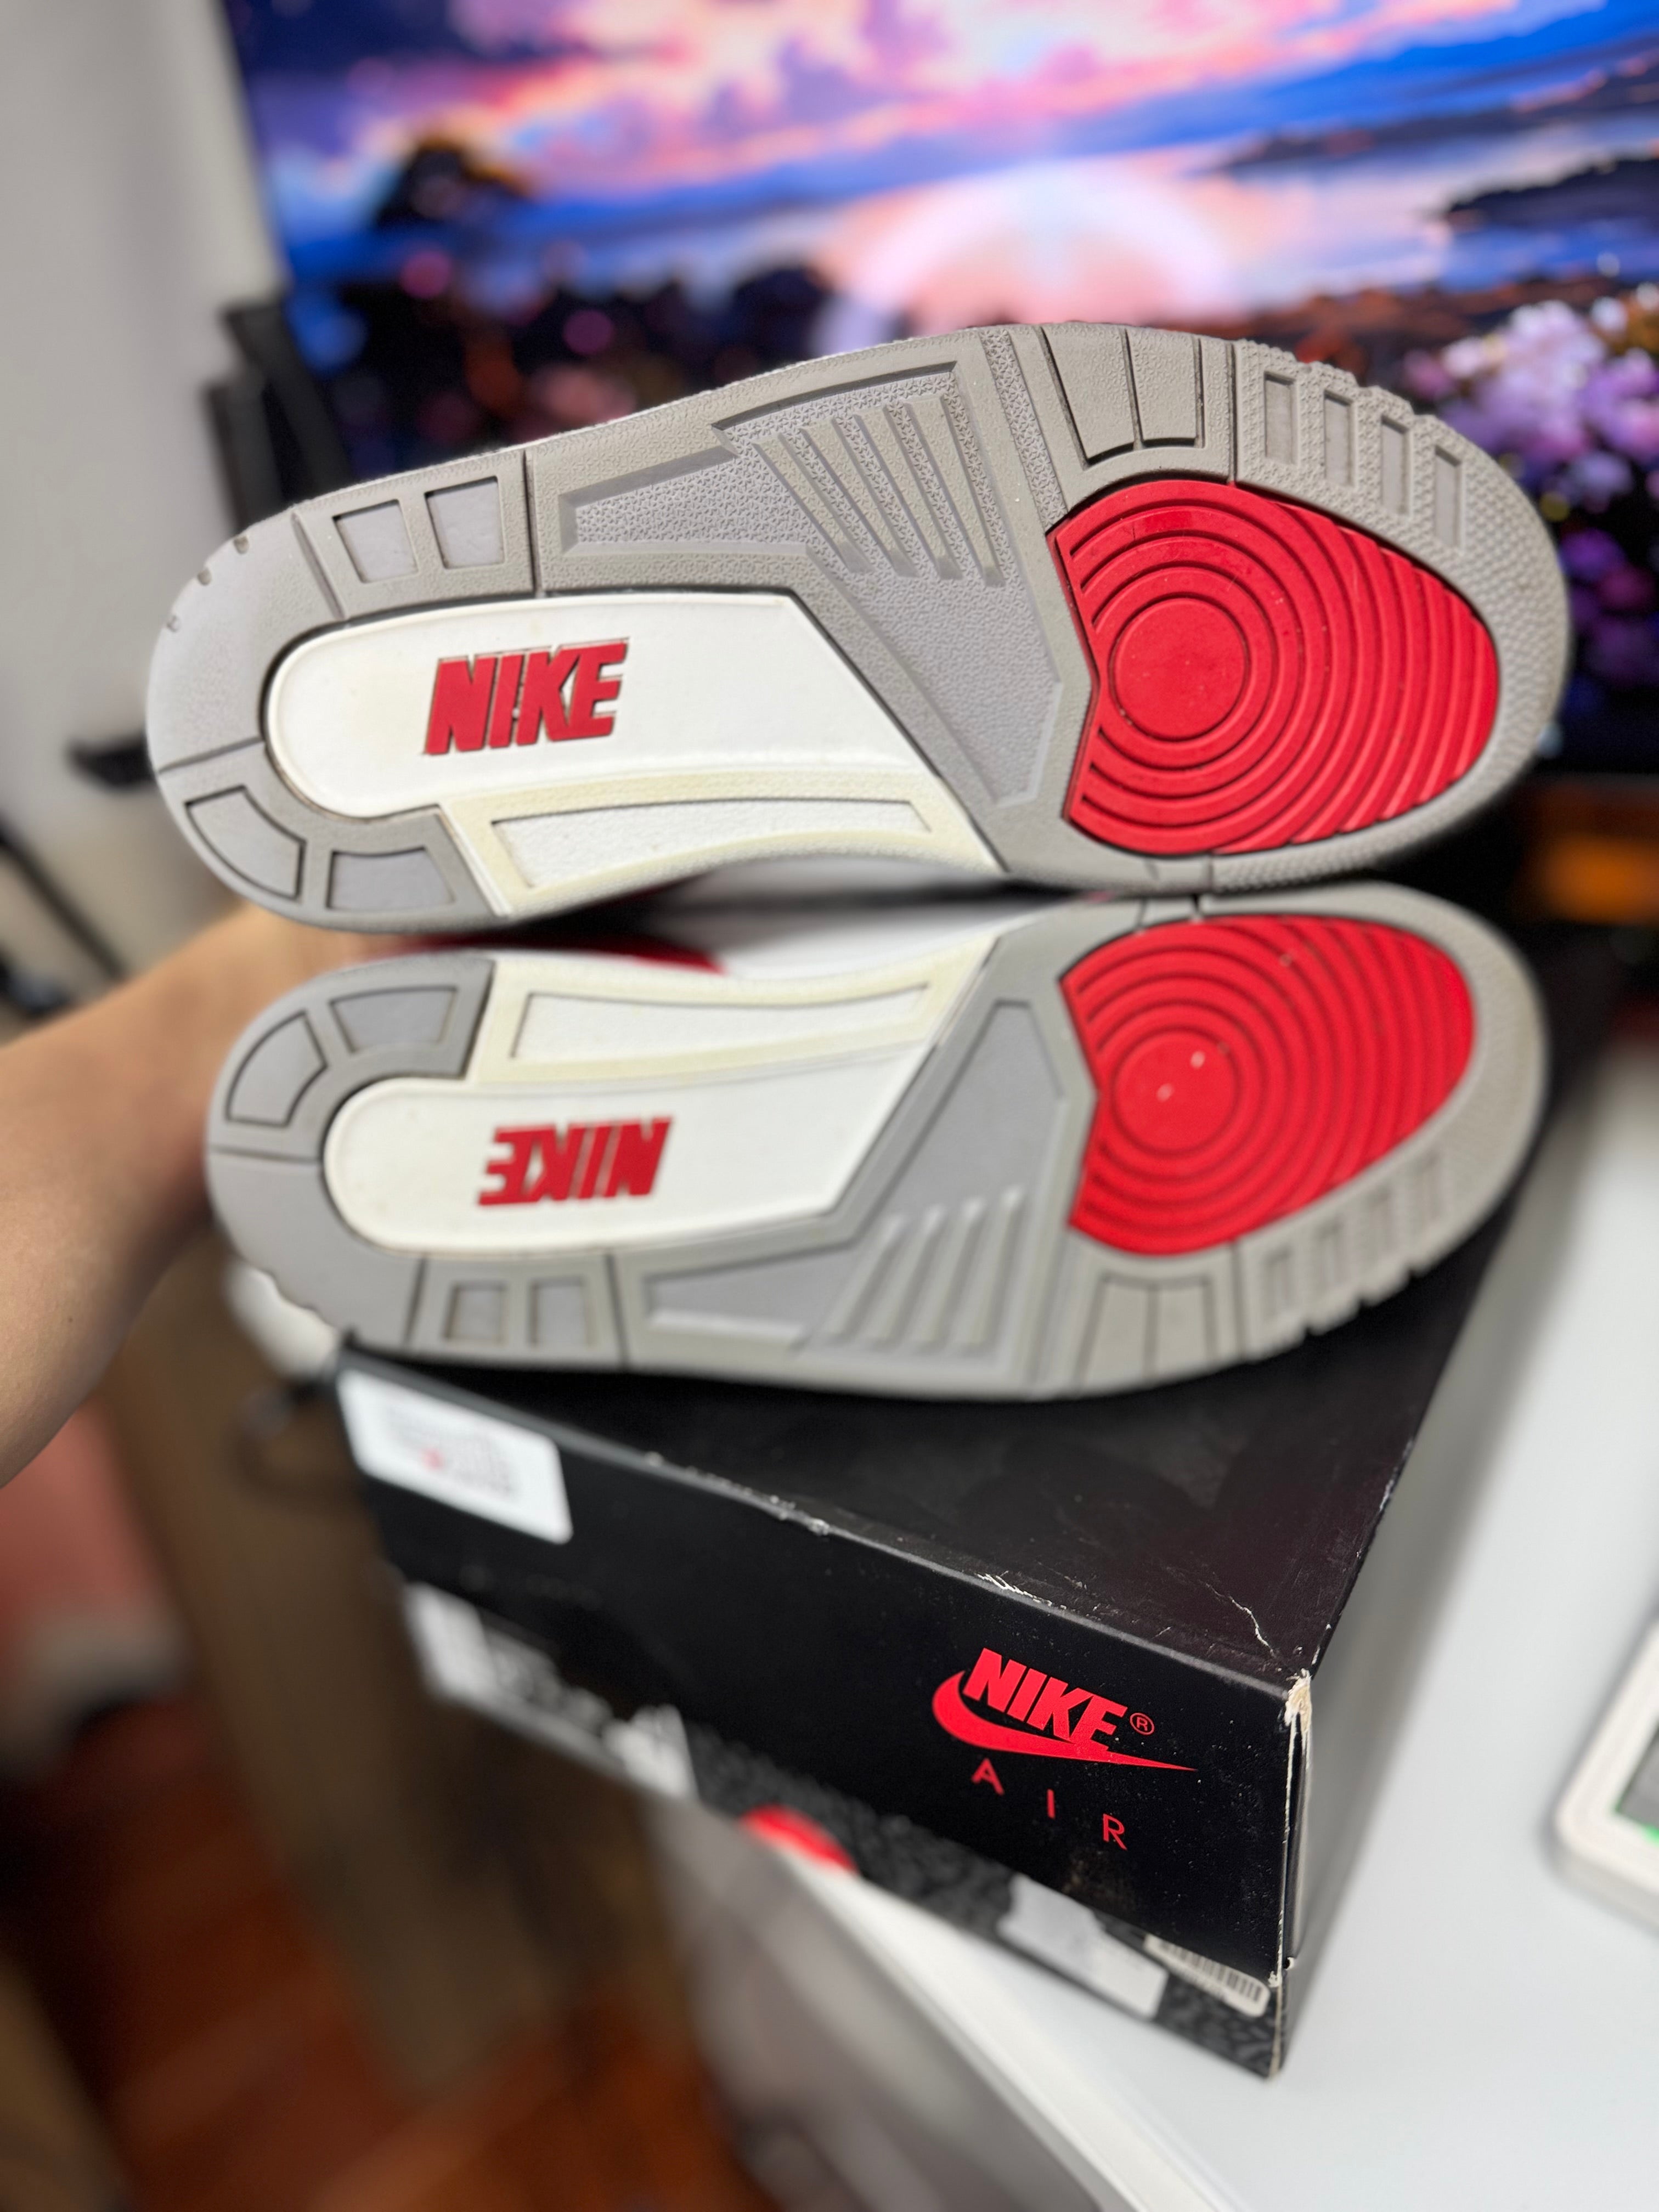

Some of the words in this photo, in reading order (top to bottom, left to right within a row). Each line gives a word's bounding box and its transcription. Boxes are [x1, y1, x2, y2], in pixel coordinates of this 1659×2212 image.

[424, 637, 629, 755] NIKE
[477, 1115, 673, 1206] NIKE
[971, 1758, 1127, 1850] AIR
